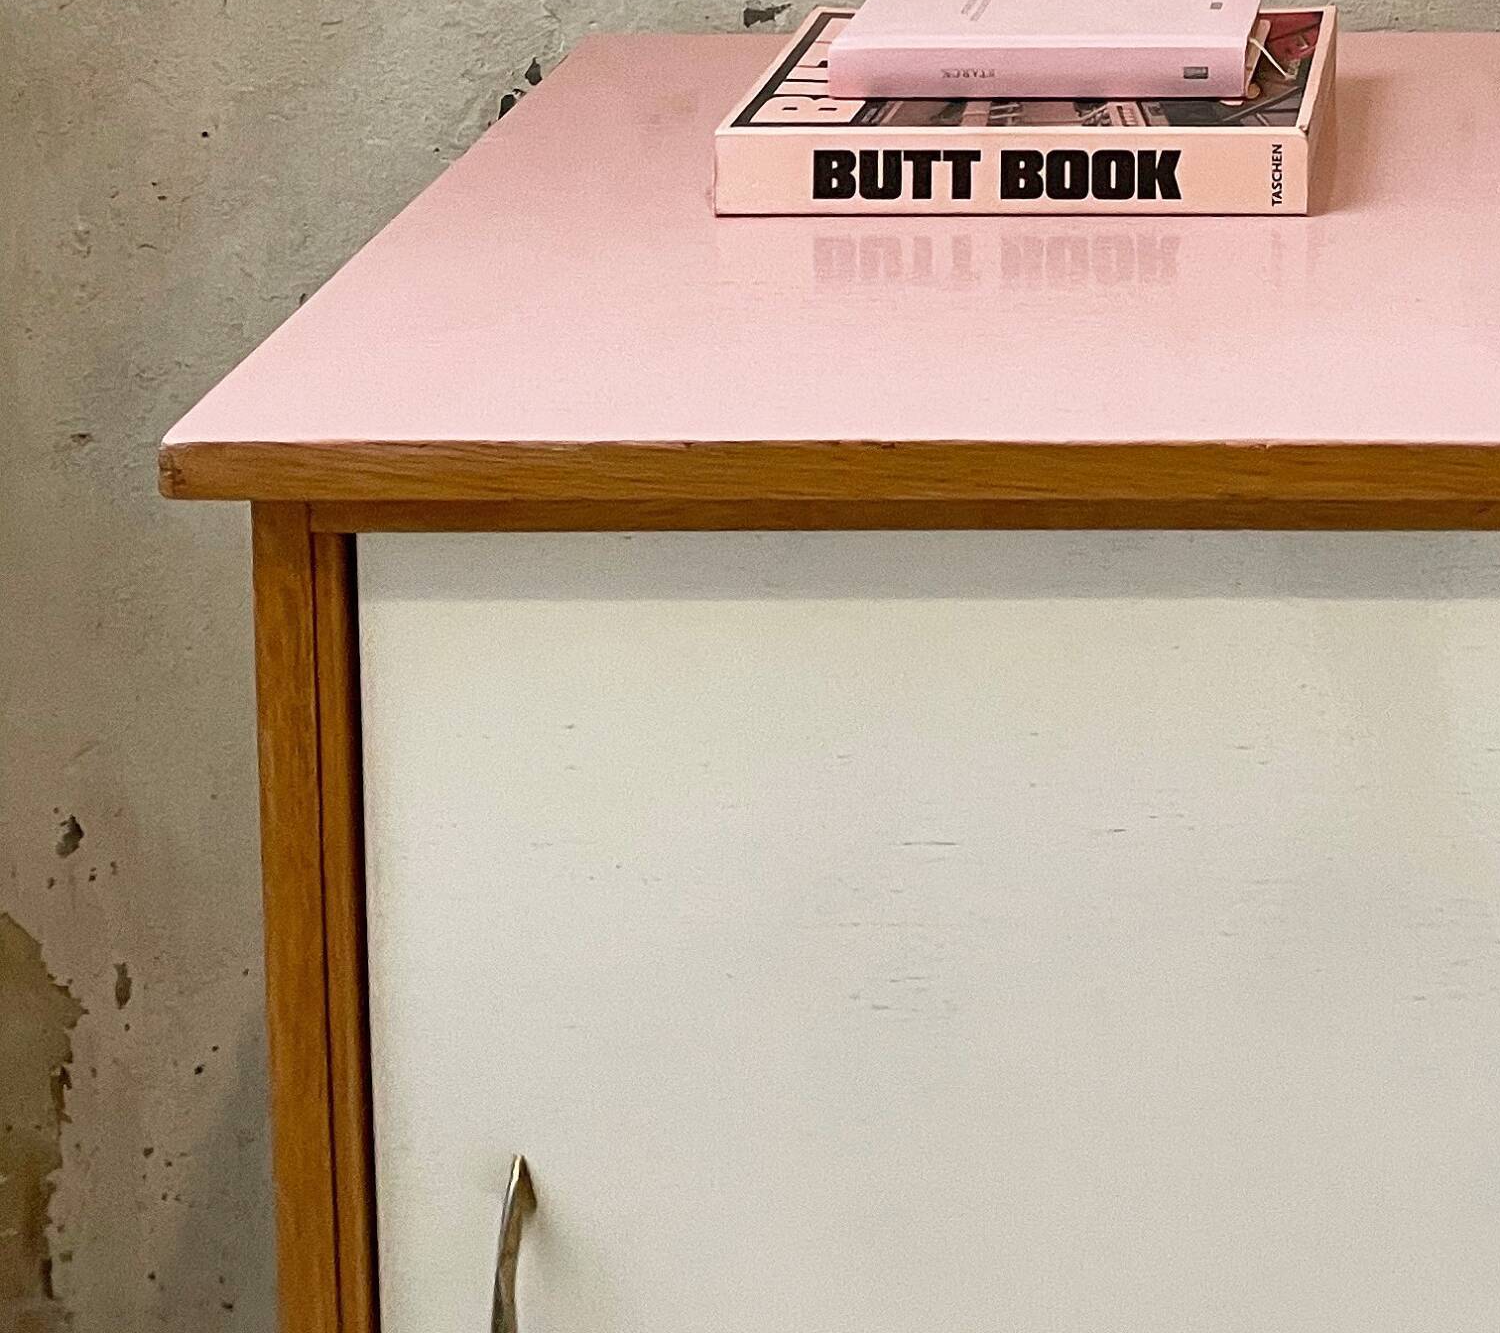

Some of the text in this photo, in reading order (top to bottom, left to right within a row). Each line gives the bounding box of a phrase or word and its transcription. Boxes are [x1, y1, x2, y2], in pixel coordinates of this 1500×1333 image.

[812, 149, 1182, 200] BUTT BOOK
[1271, 144, 1283, 207] TASCHEN
